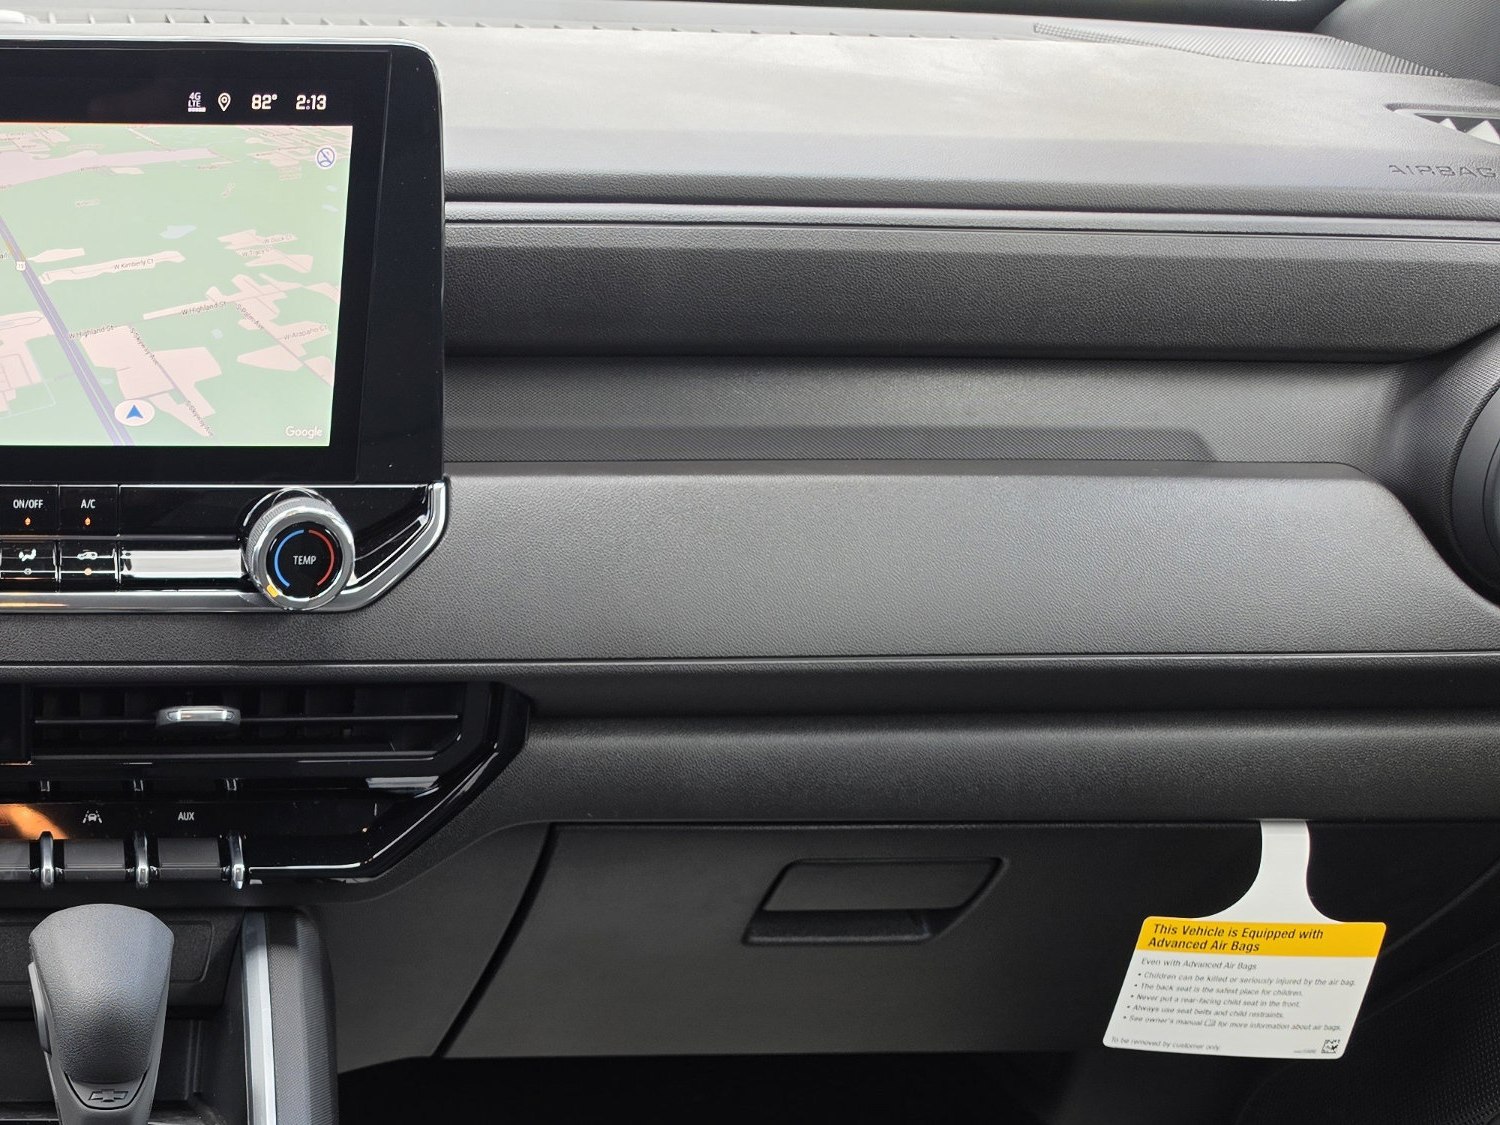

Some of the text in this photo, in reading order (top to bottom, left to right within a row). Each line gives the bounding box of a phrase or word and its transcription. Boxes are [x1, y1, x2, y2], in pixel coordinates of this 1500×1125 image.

[189, 92, 202, 100] 4G
[251, 93, 277, 110] 82°
[295, 94, 326, 110] 2:13
[1388, 165, 1496, 178] AIRBAG
[189, 302, 218, 314] Highland
[76, 327, 105, 339] Highland
[285, 425, 323, 439] Google
[13, 499, 44, 509] ON/OFF
[80, 499, 96, 509] A/C
[293, 555, 317, 566] TEMP
[178, 812, 195, 821] AUX
[1153, 923, 1324, 940] This Vehicle is Equipped with
[1148, 937, 1260, 953] Advanced Air Bags
[1141, 957, 1257, 971] Even with Advanced Air Bags
[1144, 971, 1177, 980] Children
[1195, 973, 1205, 981] be
[1207, 973, 1228, 982] killed
[1240, 976, 1273, 985] seriously
[1275, 978, 1302, 986] injured
[1303, 978, 1312, 986] by
[1156, 983, 1174, 991] back
[1132, 1005, 1159, 1013] Always
[1229, 1009, 1247, 1017] child
